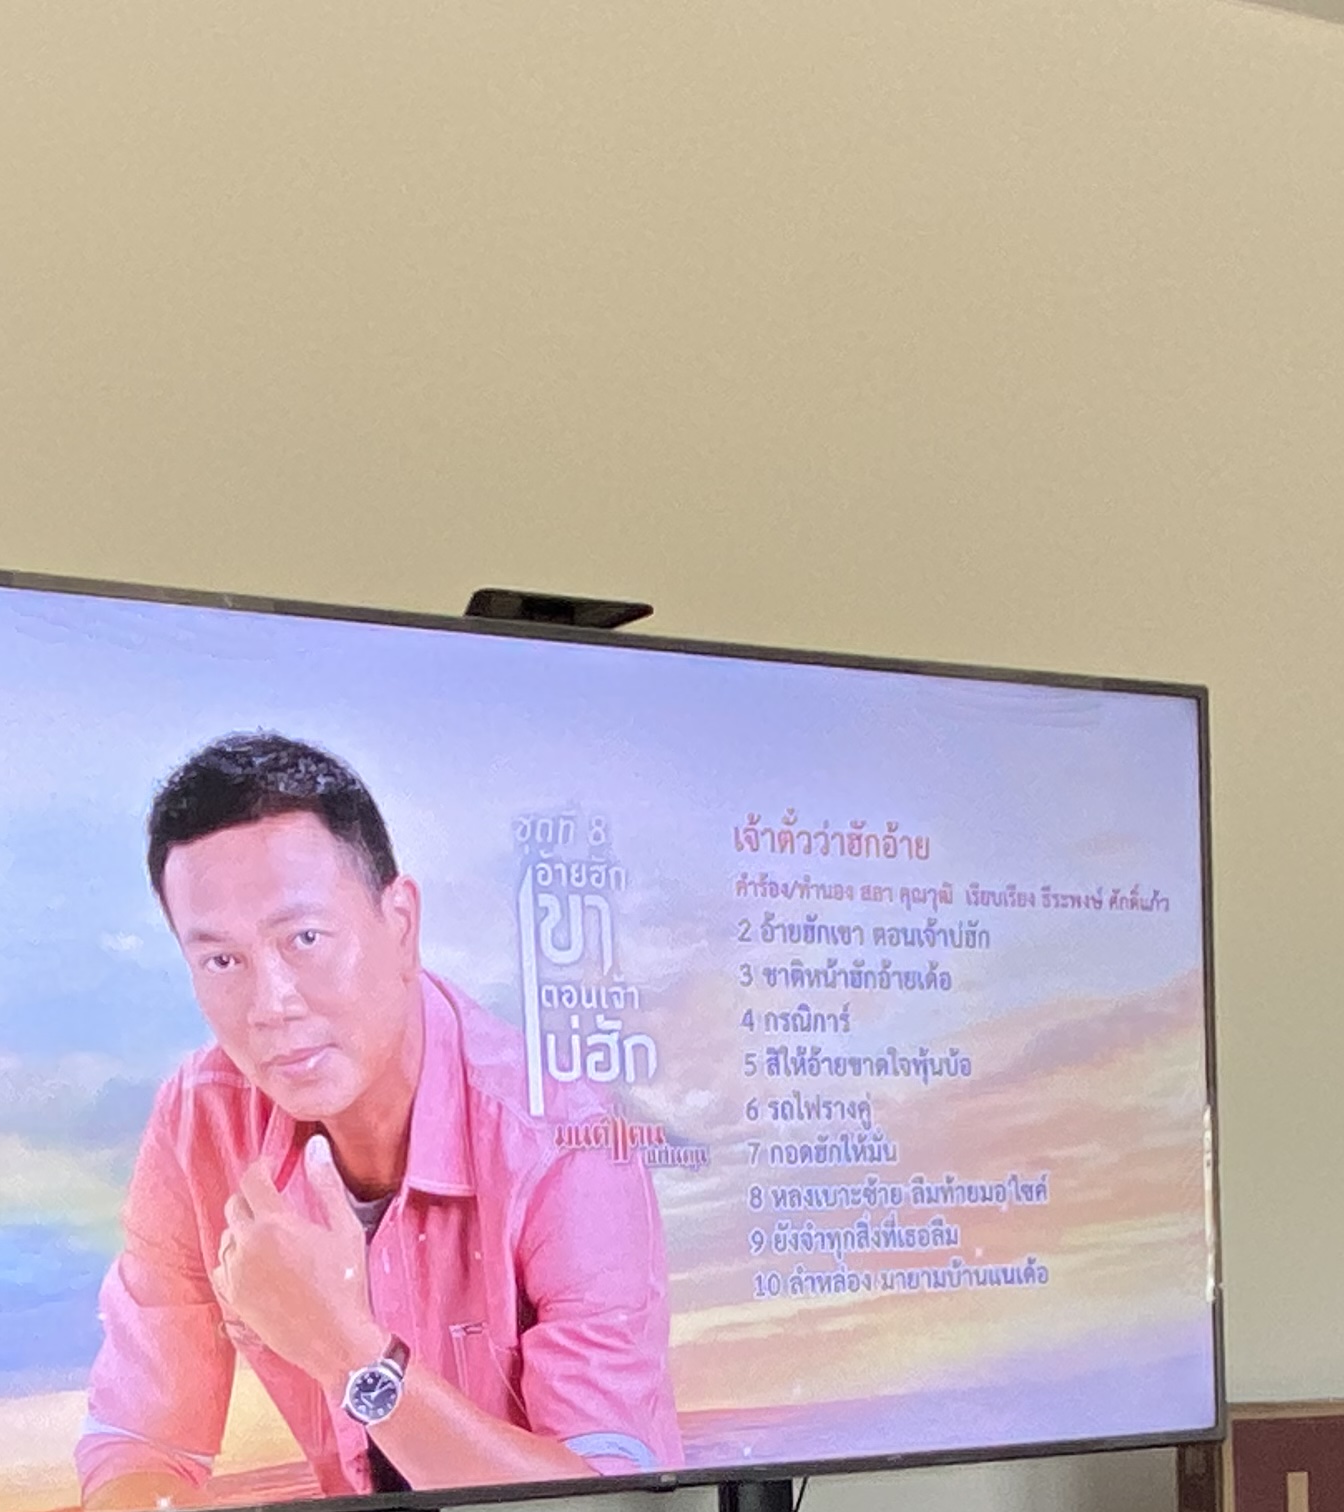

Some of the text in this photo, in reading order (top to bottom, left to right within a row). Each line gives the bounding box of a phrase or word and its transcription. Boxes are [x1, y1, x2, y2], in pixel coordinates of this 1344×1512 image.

[587, 815, 606, 846] 8
[737, 918, 752, 943] 2
[760, 911, 865, 946] อ้ายฮักเขา
[739, 963, 754, 987] 3
[541, 974, 640, 1010] ตอนเจ้า
[741, 1002, 851, 1033] 4 กรณิการ์
[744, 1052, 757, 1077] 5
[746, 1090, 872, 1130] 6 รถไฟรางคู่
[748, 1127, 898, 1166] 7 กอดฮักให้มั่น
[749, 1186, 763, 1208] 8
[751, 1230, 764, 1254] 9
[755, 1274, 780, 1297] 10
